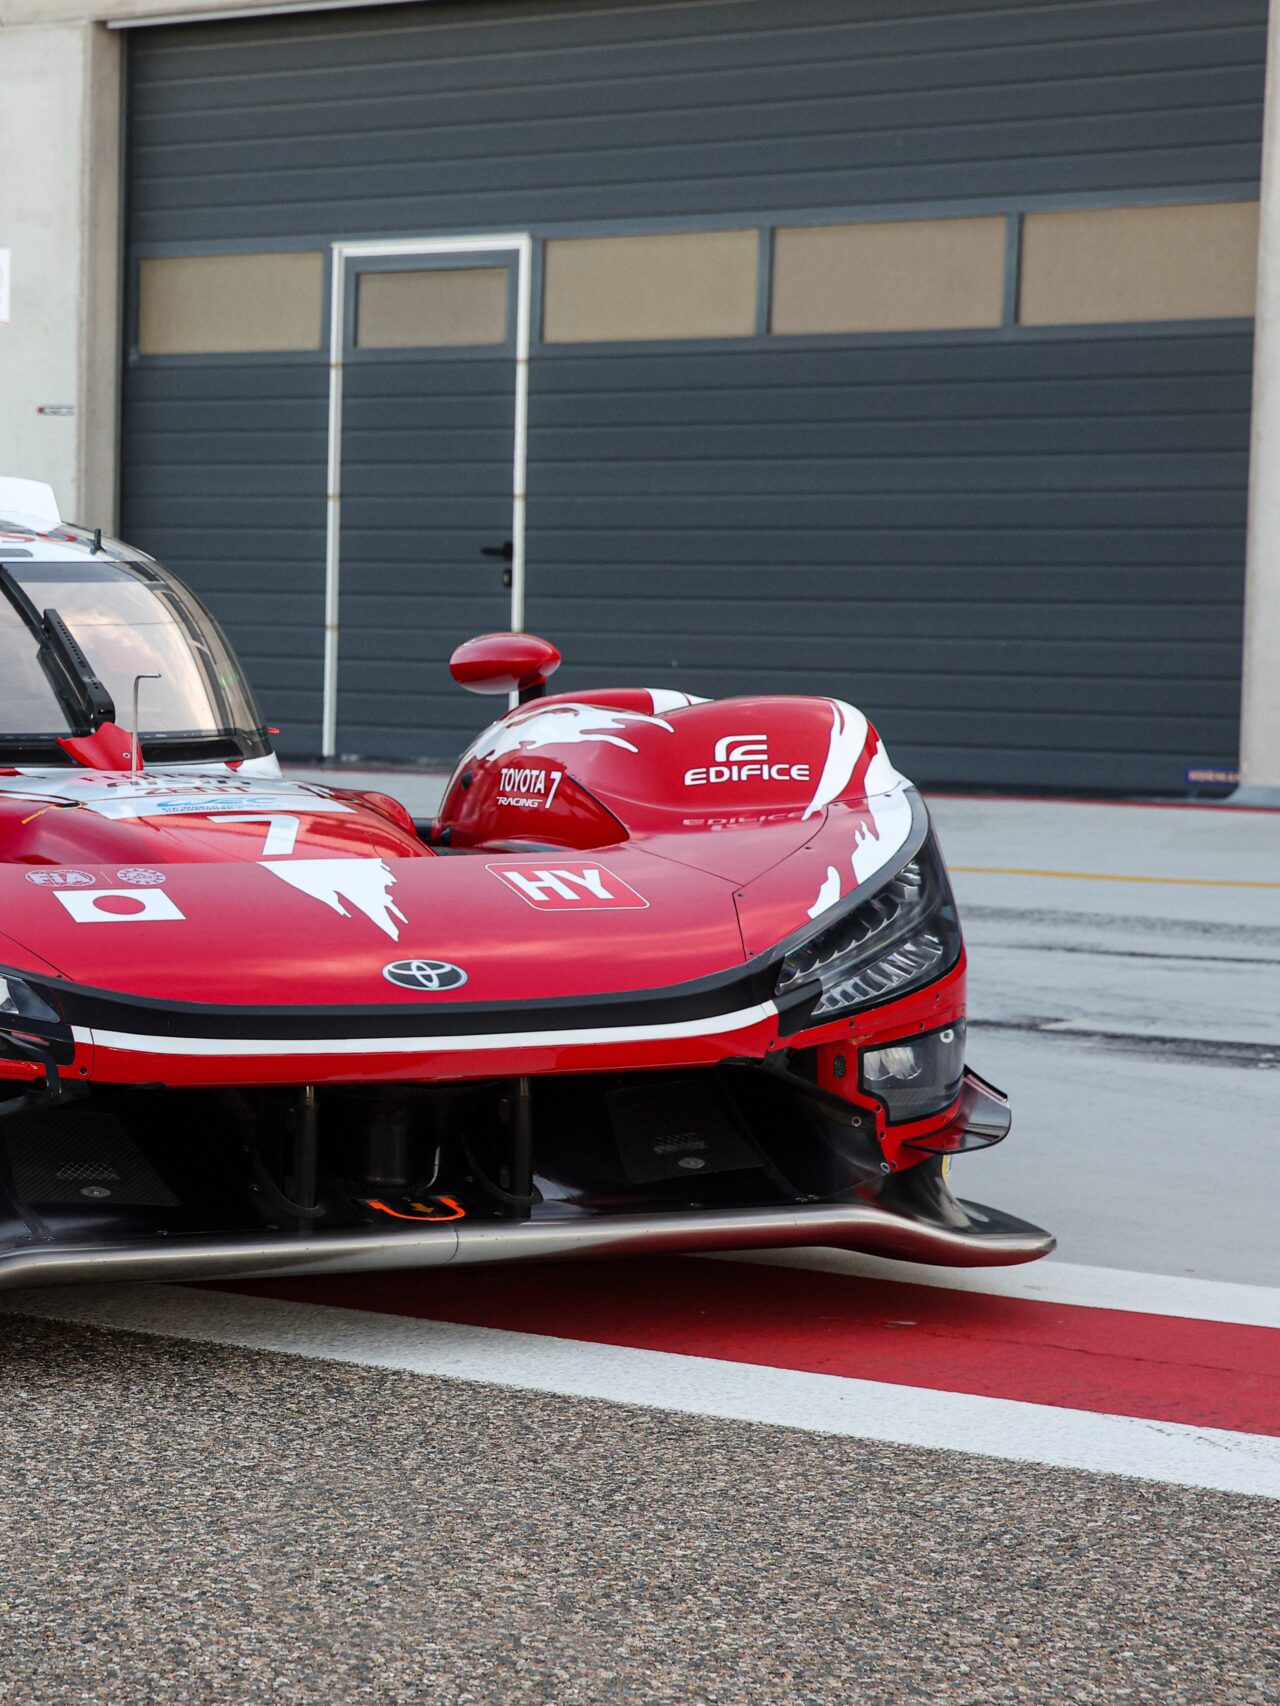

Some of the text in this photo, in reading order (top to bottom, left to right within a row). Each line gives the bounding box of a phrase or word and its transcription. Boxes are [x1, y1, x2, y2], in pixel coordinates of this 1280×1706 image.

[684, 763, 810, 786] EDIFICE
[496, 796, 543, 808] RACING
[500, 768, 562, 809] TOYOTA 7
[206, 814, 300, 856] 7
[29, 872, 89, 886] FIA
[502, 869, 615, 900] HY
